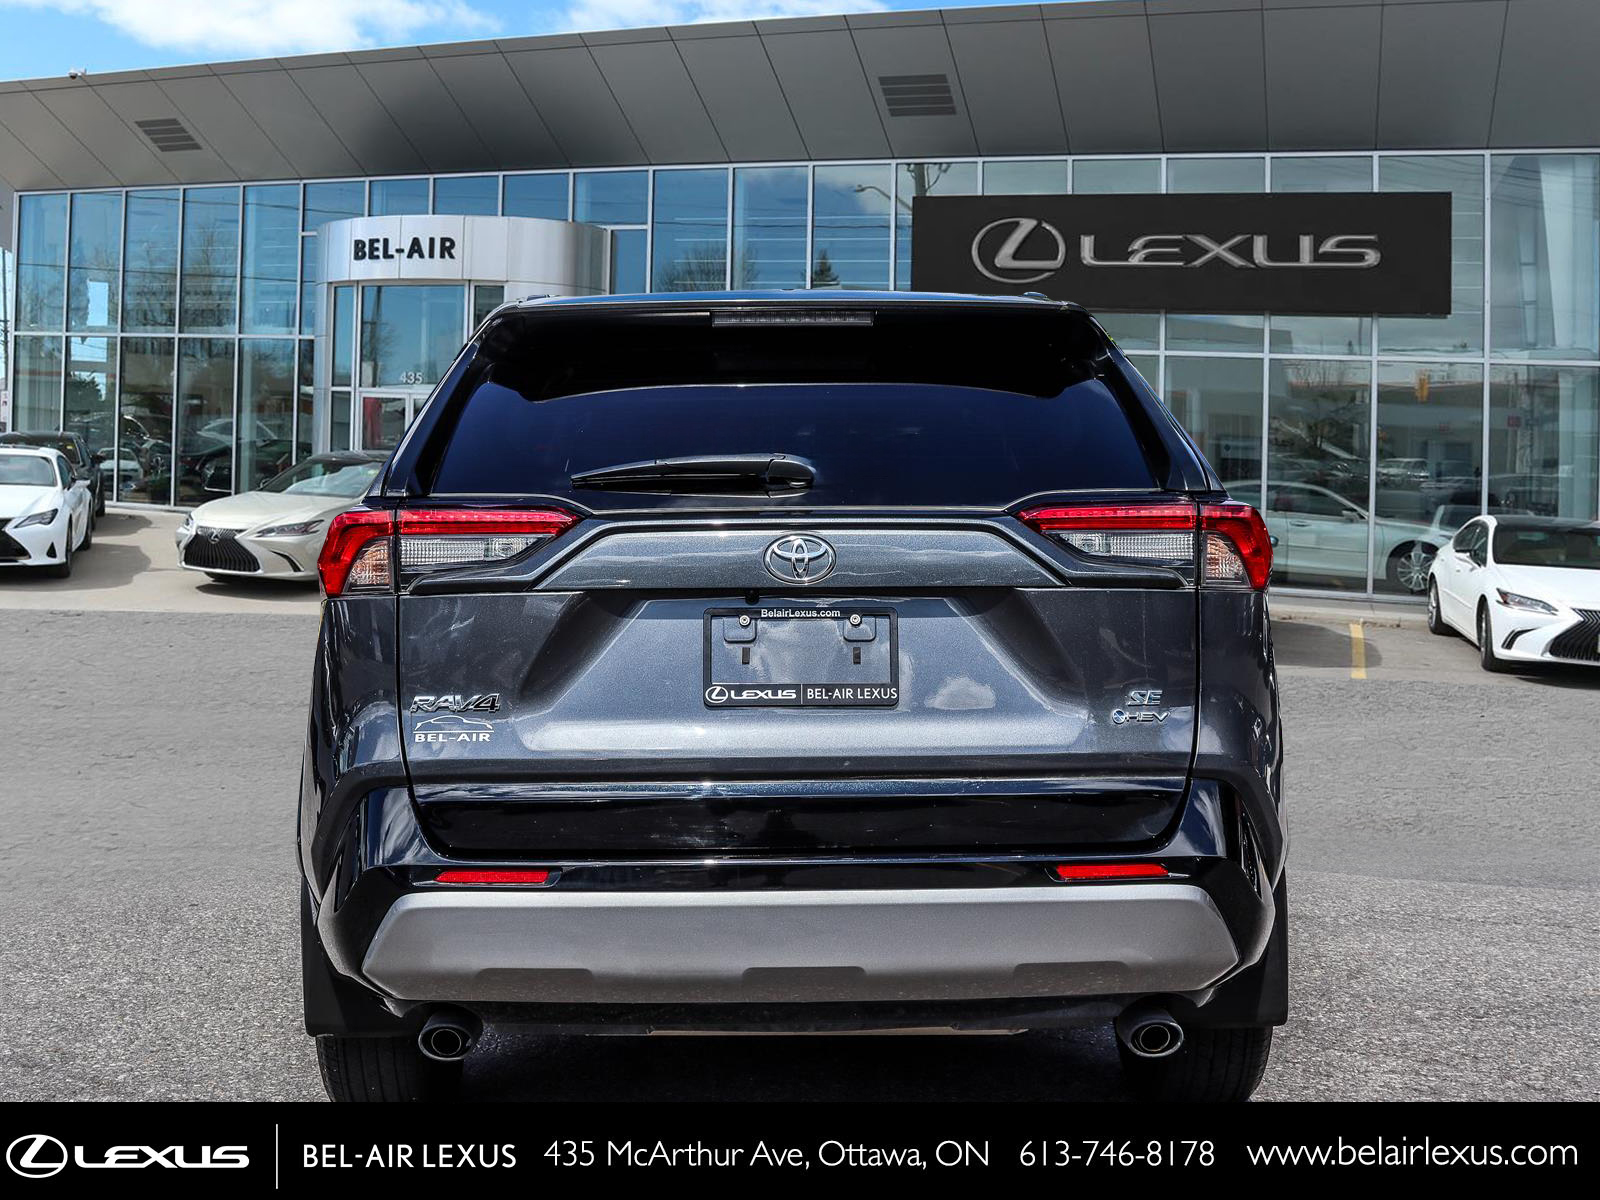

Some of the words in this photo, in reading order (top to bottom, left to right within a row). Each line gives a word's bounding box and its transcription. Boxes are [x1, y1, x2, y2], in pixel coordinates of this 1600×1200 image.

[353, 237, 456, 261] BEL-AIR
[1079, 233, 1382, 269] LEXUS
[400, 371, 424, 385] 435
[760, 608, 841, 618] BelairLexus.com
[730, 688, 797, 700] LEXUS
[807, 688, 853, 699] BEL-AIR
[857, 688, 898, 699] LEXUS
[1127, 690, 1163, 706] SE
[410, 693, 500, 713] RAV4
[1125, 711, 1171, 722] HEV
[414, 733, 491, 743] BEL-AIR
